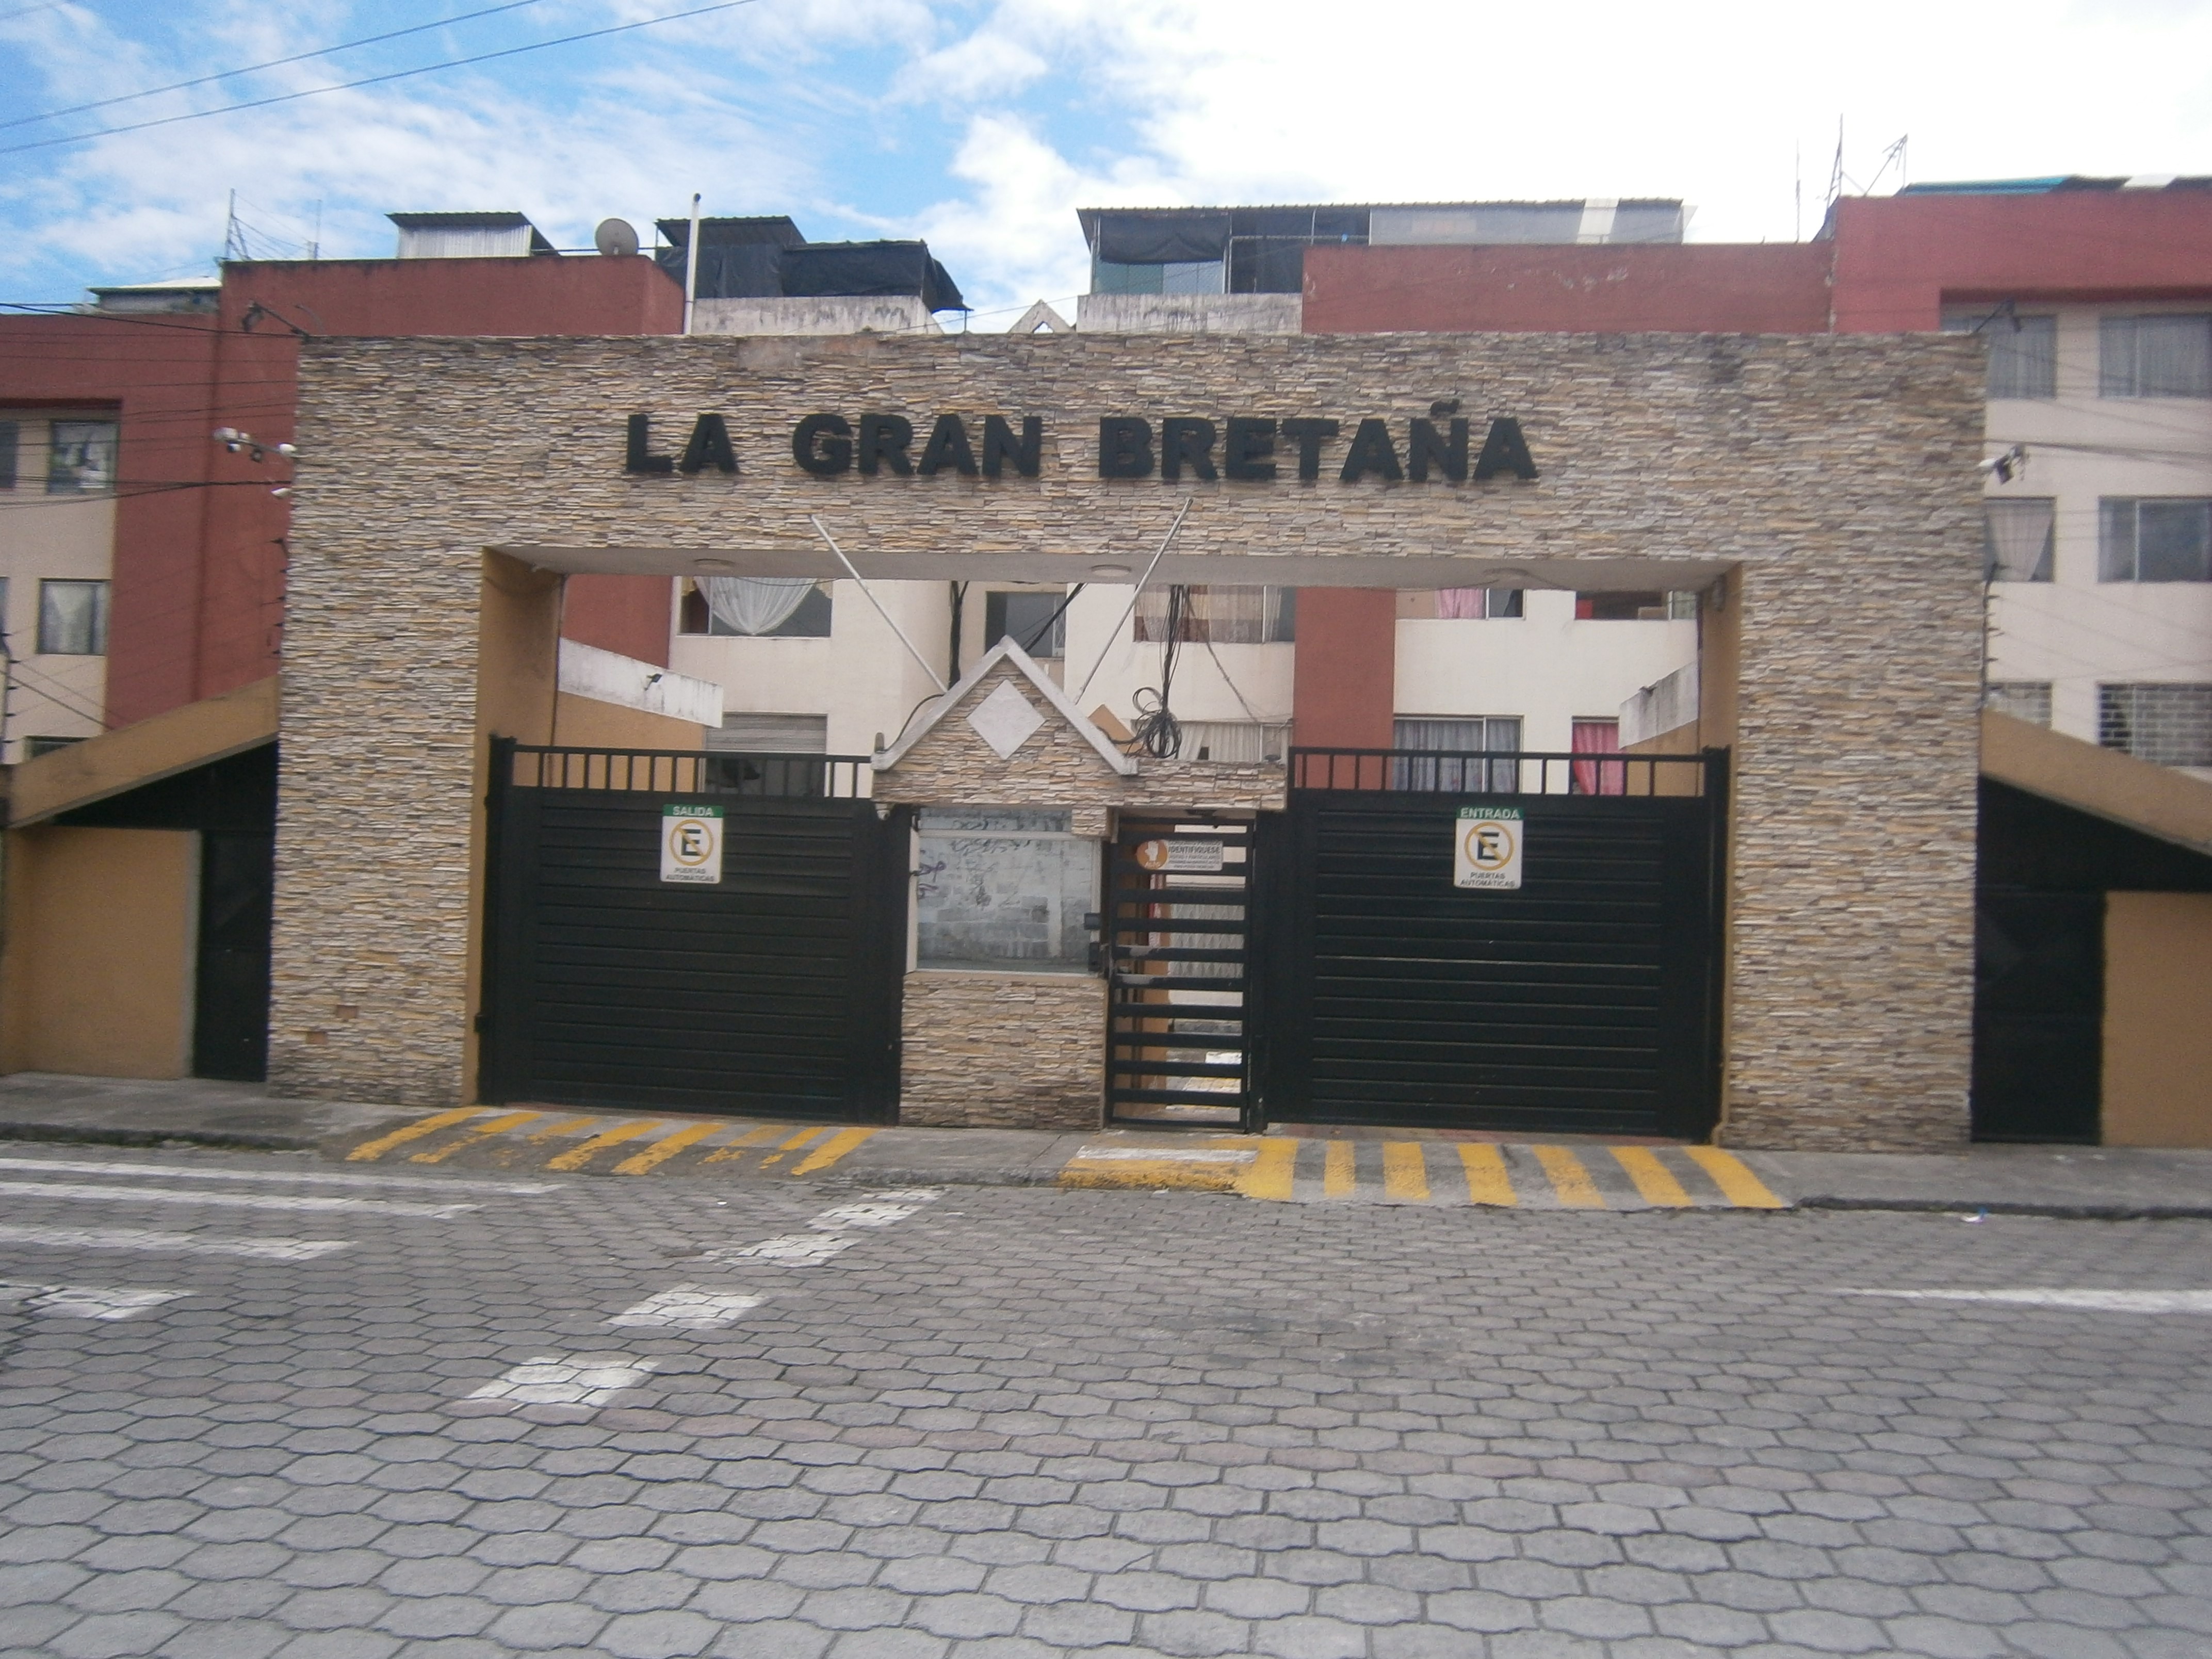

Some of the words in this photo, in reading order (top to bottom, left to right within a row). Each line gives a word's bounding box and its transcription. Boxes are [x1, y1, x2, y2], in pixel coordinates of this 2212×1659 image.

[626, 413, 740, 474] LA
[792, 413, 1042, 476] GRAN
[1098, 399, 1539, 481] BRETAÑA
[672, 806, 714, 817] SALIDA
[1460, 807, 1521, 819] ENTRADA
